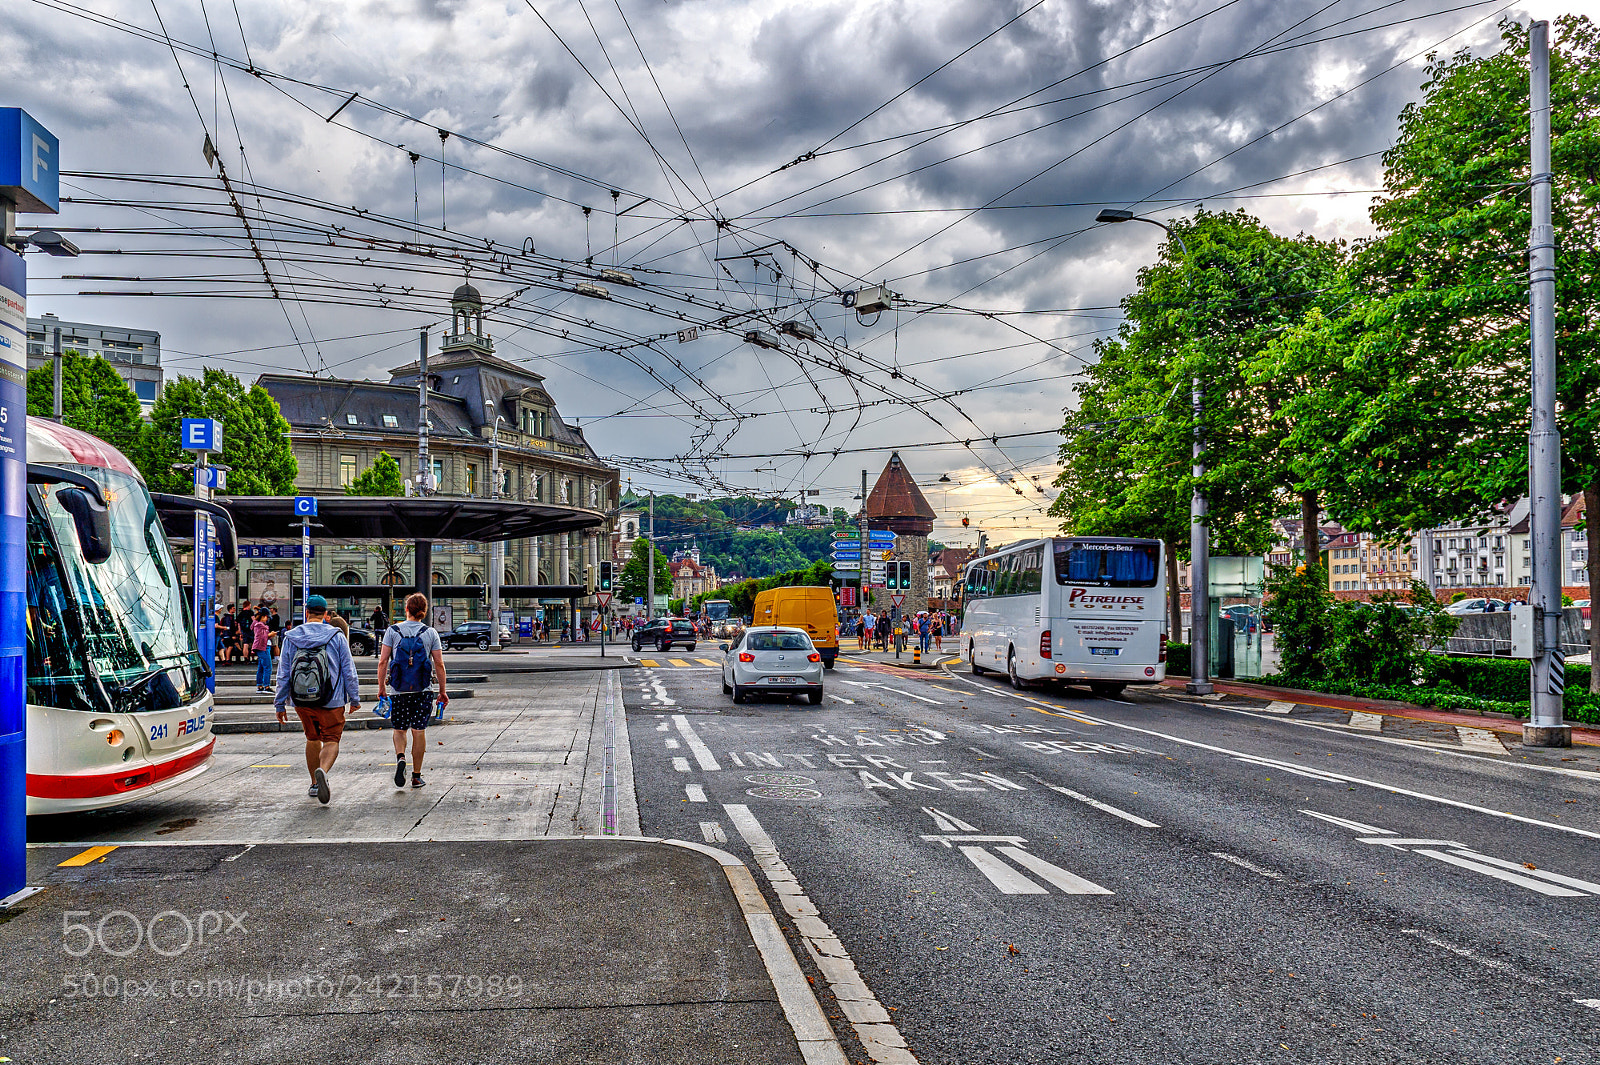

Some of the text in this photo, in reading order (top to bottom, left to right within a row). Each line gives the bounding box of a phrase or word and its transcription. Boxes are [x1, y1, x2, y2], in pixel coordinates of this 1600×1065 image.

[32, 133, 50, 183] F
[679, 331, 686, 341] B
[189, 423, 206, 444] E
[214, 425, 221, 447] E
[530, 439, 547, 448] POST
[217, 470, 225, 485] D
[298, 499, 310, 512] C
[199, 528, 205, 542] 9
[252, 548, 260, 556] B
[1081, 543, 1134, 552] Mercedes-Benz
[150, 715, 205, 741] 241 RBUS
[810, 733, 945, 747] HARD
[858, 770, 1028, 792] AKEN
